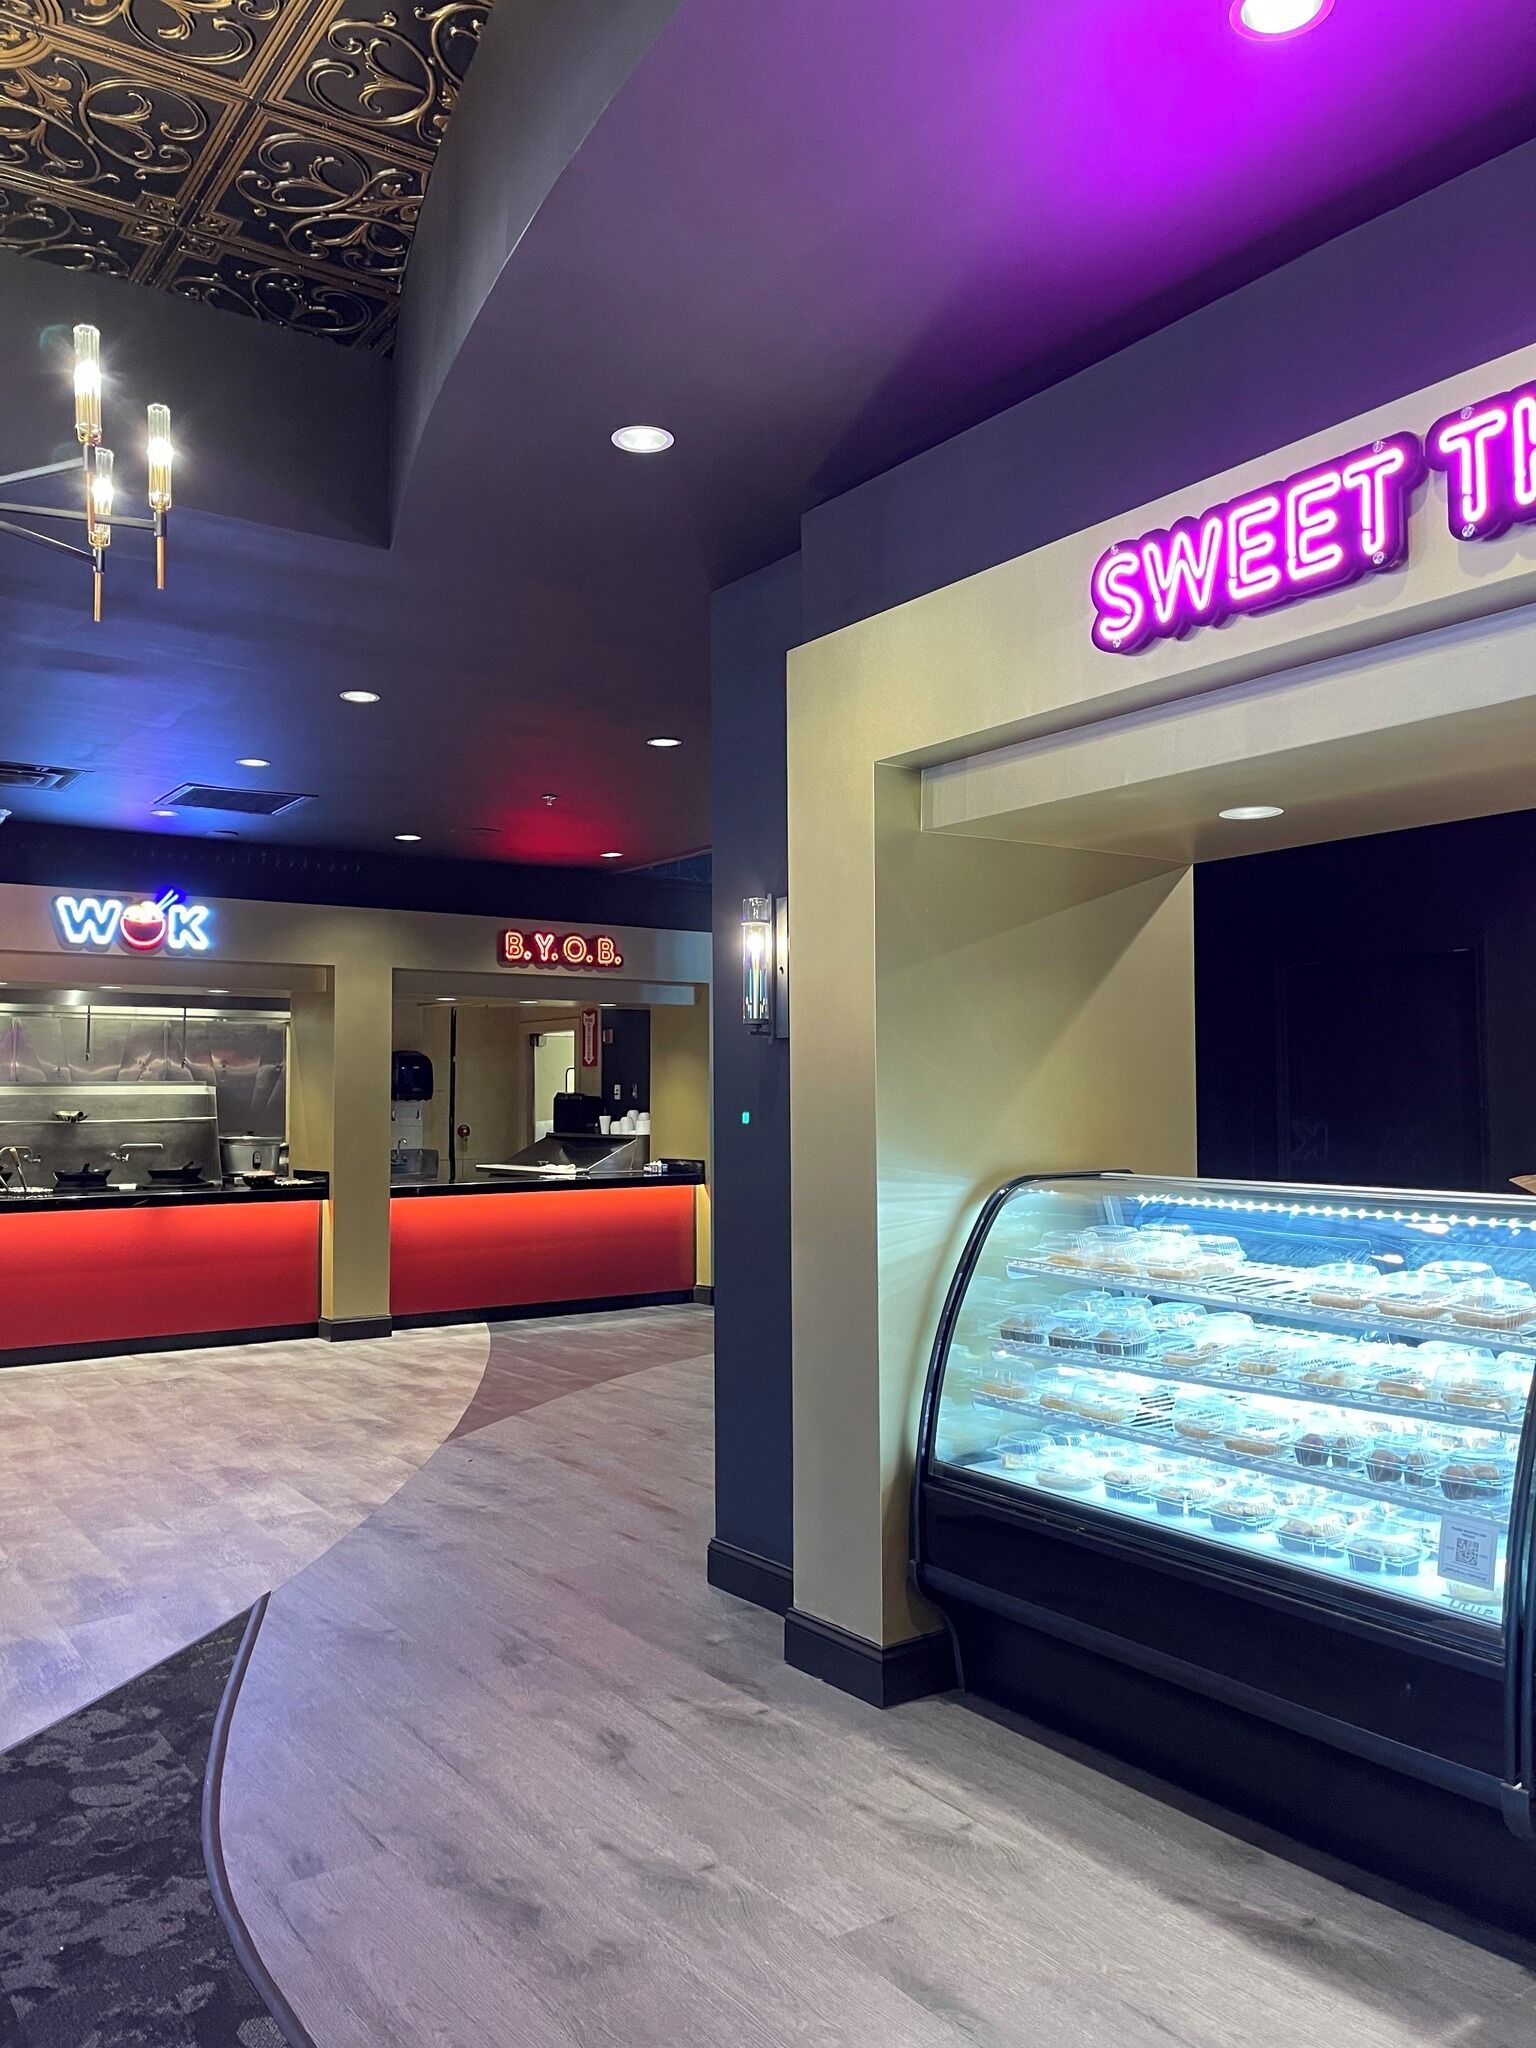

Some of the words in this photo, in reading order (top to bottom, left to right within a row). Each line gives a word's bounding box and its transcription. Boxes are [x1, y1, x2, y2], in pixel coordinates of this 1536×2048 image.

[1097, 447, 1405, 641] SWEET
[56, 893, 210, 951] WOK
[505, 931, 622, 965] B.Y.O.B.
